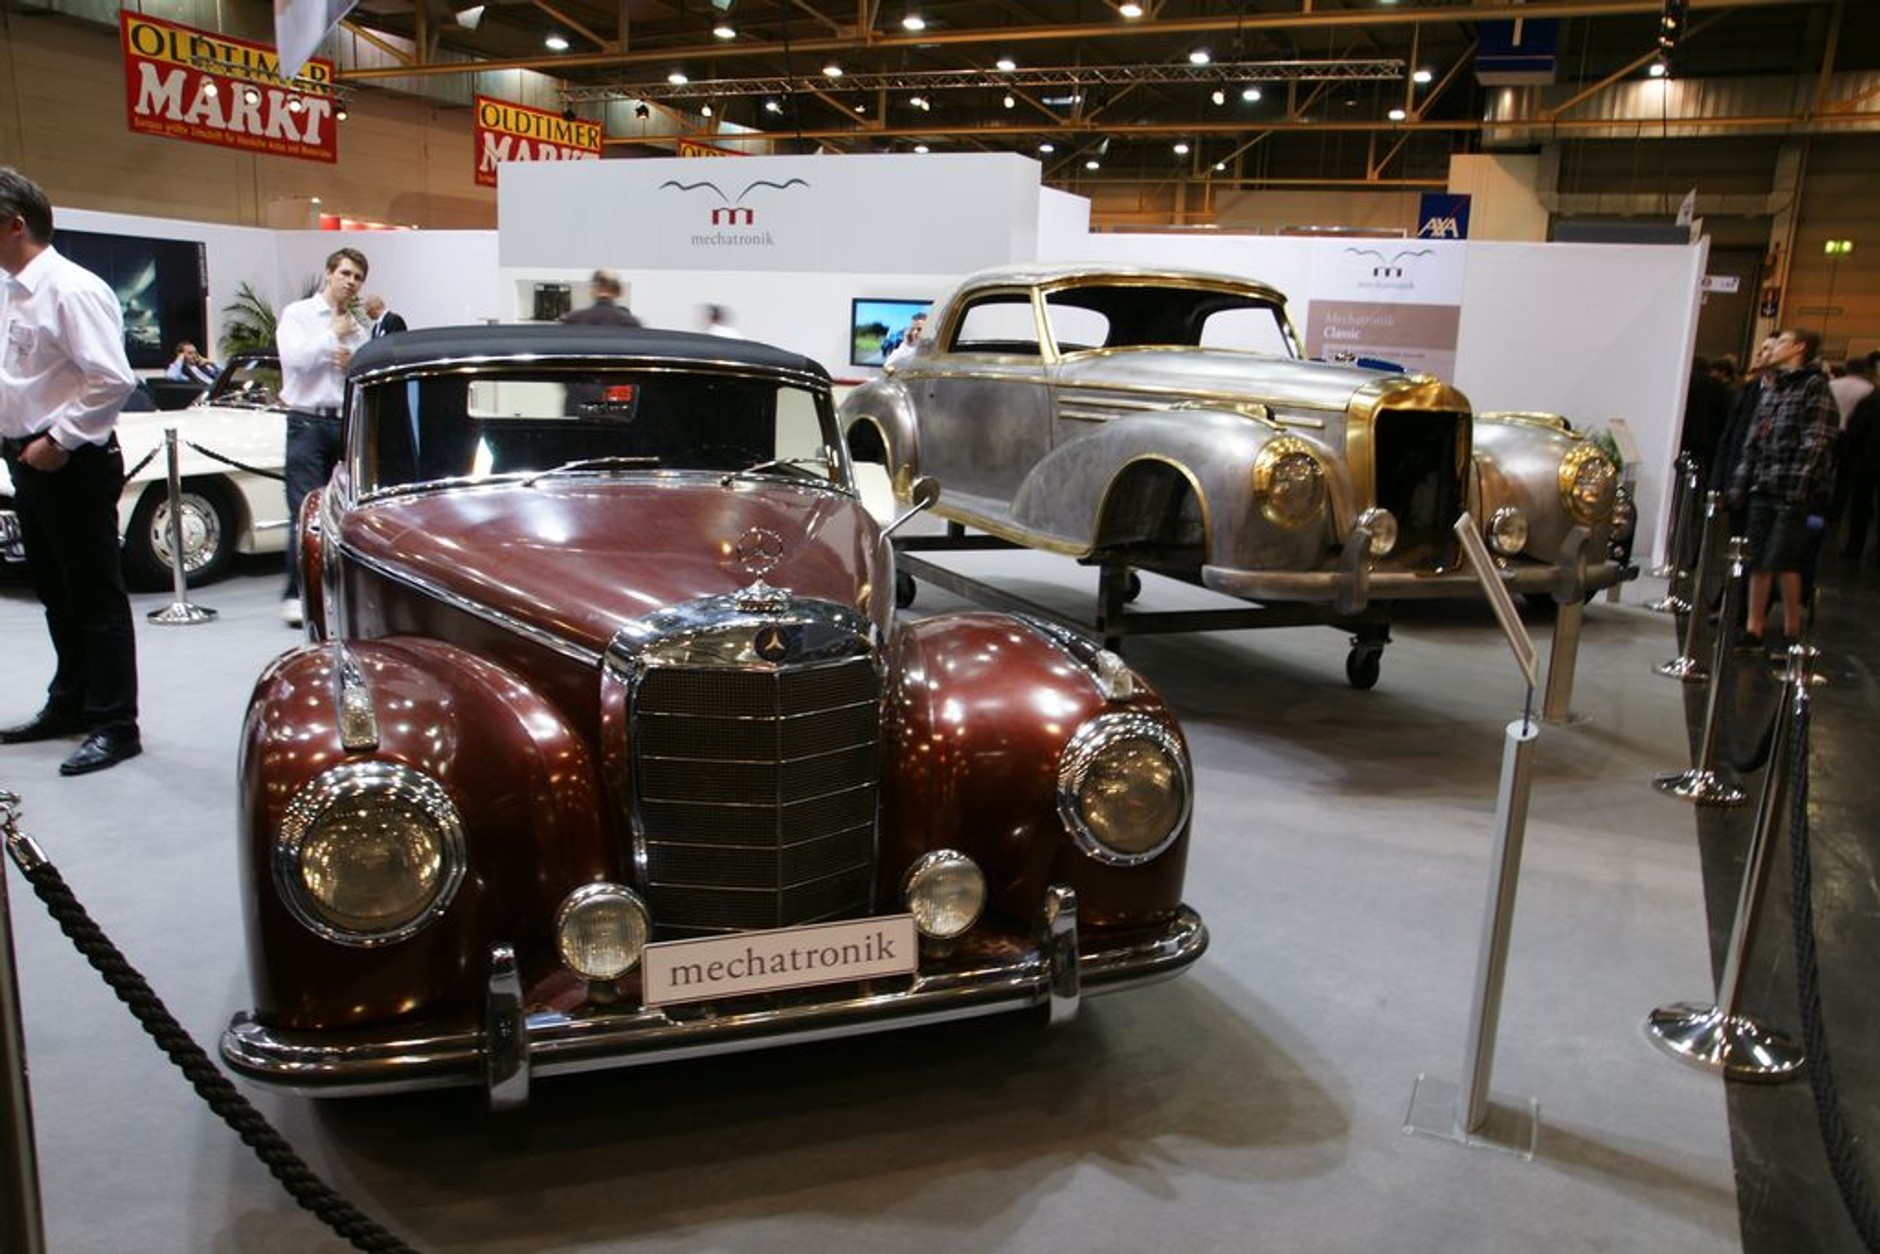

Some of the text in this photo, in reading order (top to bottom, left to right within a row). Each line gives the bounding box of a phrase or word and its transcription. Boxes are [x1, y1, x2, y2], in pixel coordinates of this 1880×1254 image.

[131, 24, 328, 94] OLDTIMR
[134, 62, 331, 145] MARKT
[481, 103, 599, 149] OLDTIMER
[691, 232, 774, 246] mechatronik
[1417, 217, 1460, 238] AXA
[669, 932, 896, 987] mechatronik
